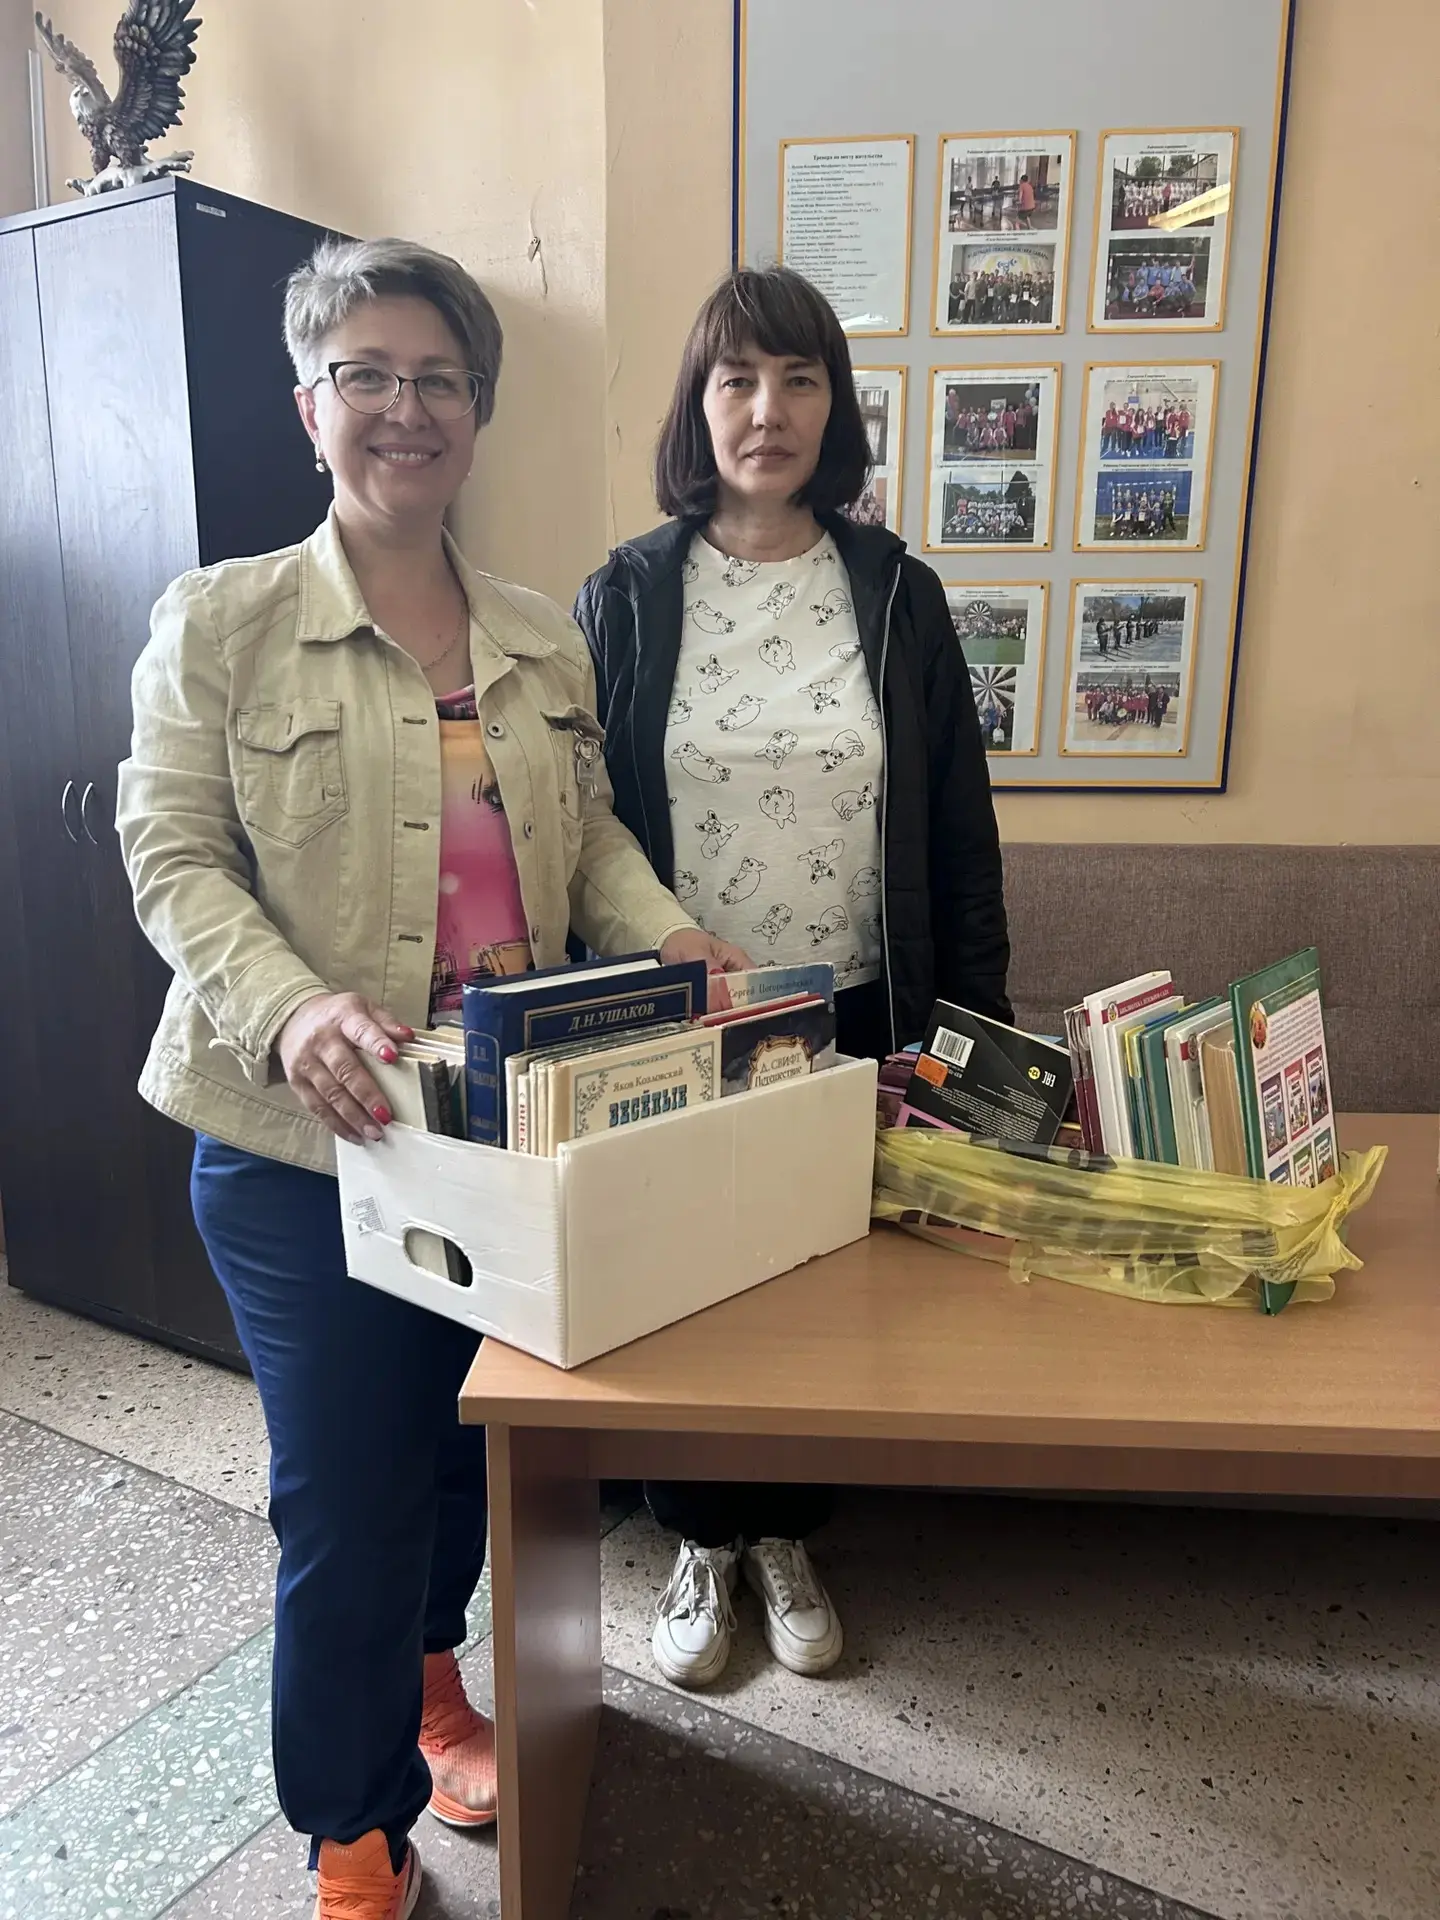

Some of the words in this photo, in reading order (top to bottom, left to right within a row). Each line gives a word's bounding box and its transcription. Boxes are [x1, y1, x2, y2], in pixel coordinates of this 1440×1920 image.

[728, 985, 755, 999] Сергей
[568, 1002, 655, 1033] Д.Н.УШАКОВ
[771, 1052, 801, 1070] СВИФТ
[613, 1080, 634, 1093] Яков
[635, 1065, 684, 1087] Козловский
